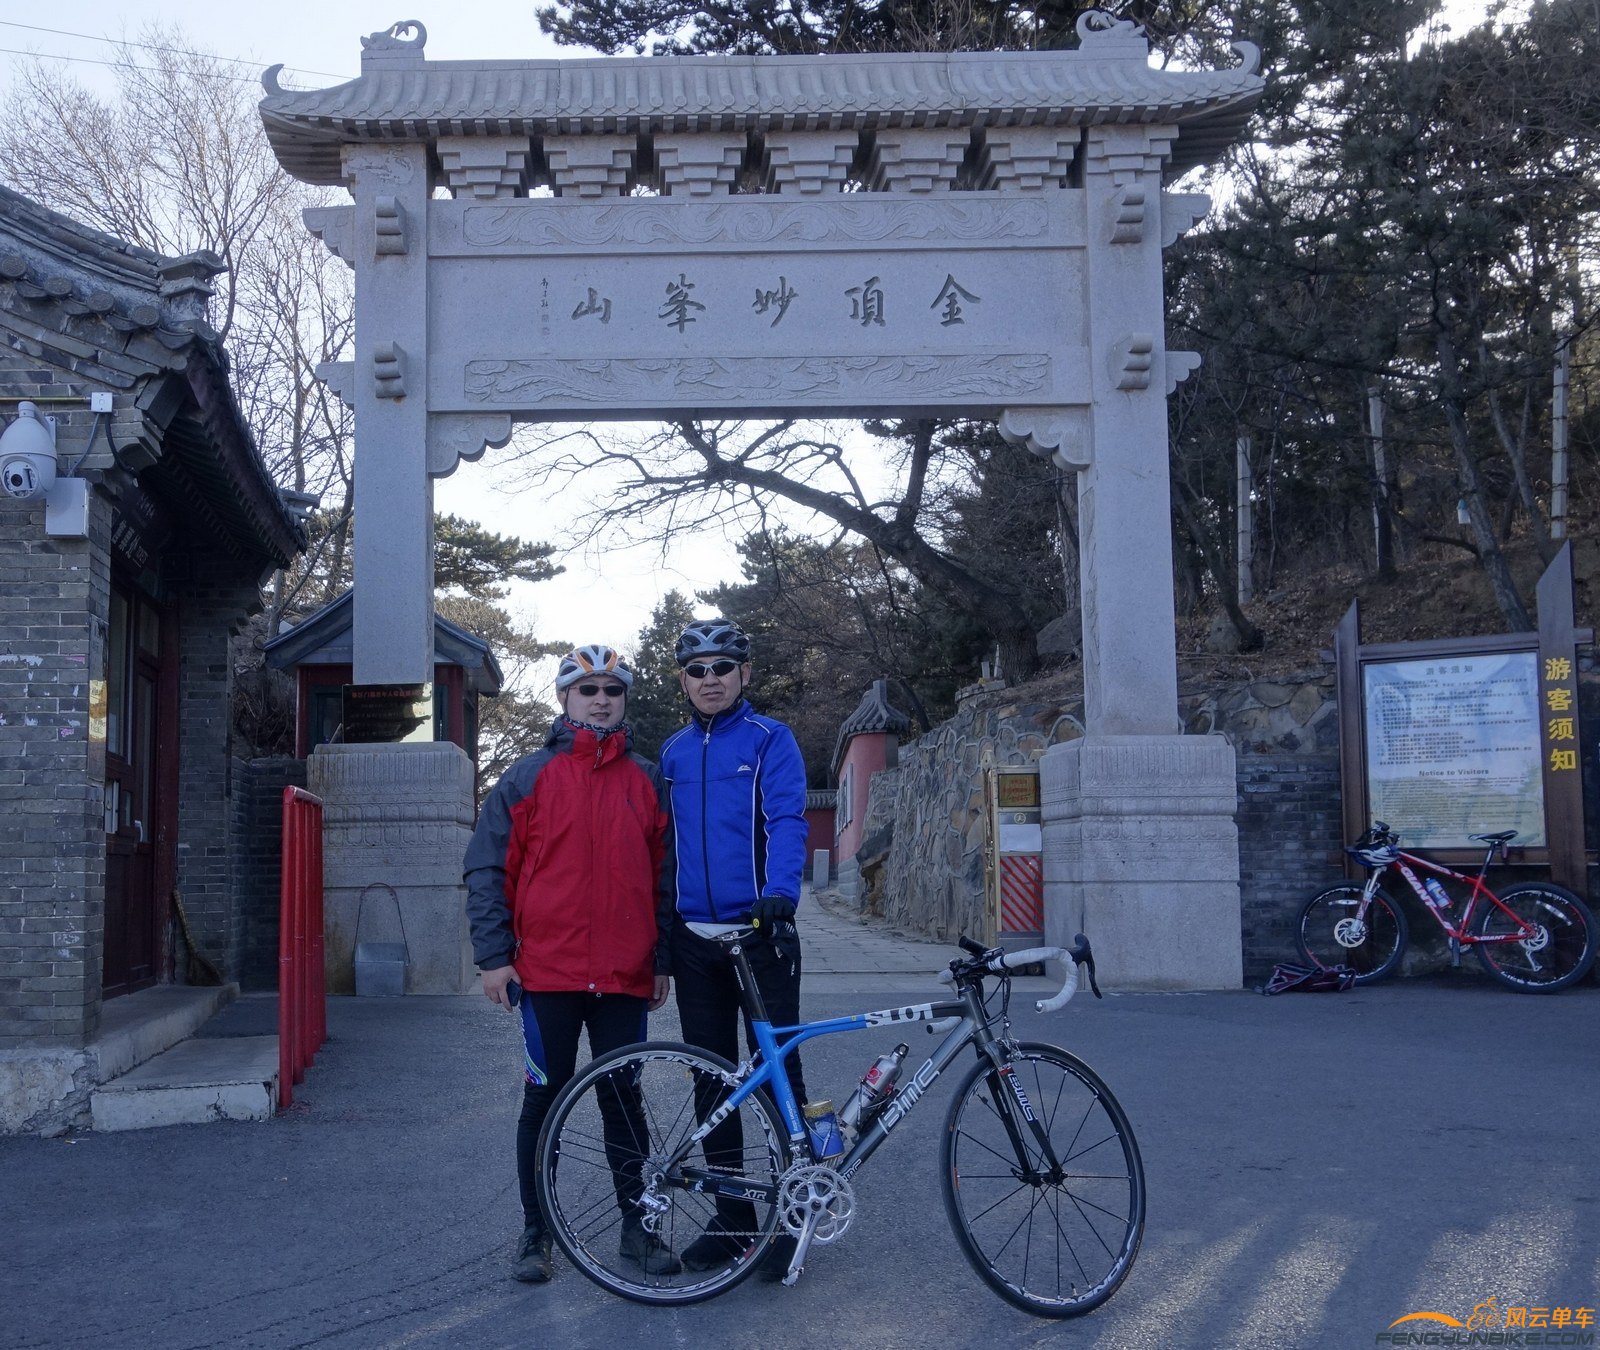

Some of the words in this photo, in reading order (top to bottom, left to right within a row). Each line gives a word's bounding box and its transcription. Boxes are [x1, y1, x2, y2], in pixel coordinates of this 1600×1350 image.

[1545, 657, 1577, 771] 游客须知
[1458, 768, 1490, 776] Visitors
[1401, 866, 1438, 909] GIANT
[878, 1058, 940, 1134] BMC
[1008, 1073, 1038, 1122] BMC
[742, 1188, 767, 1200] XTR
